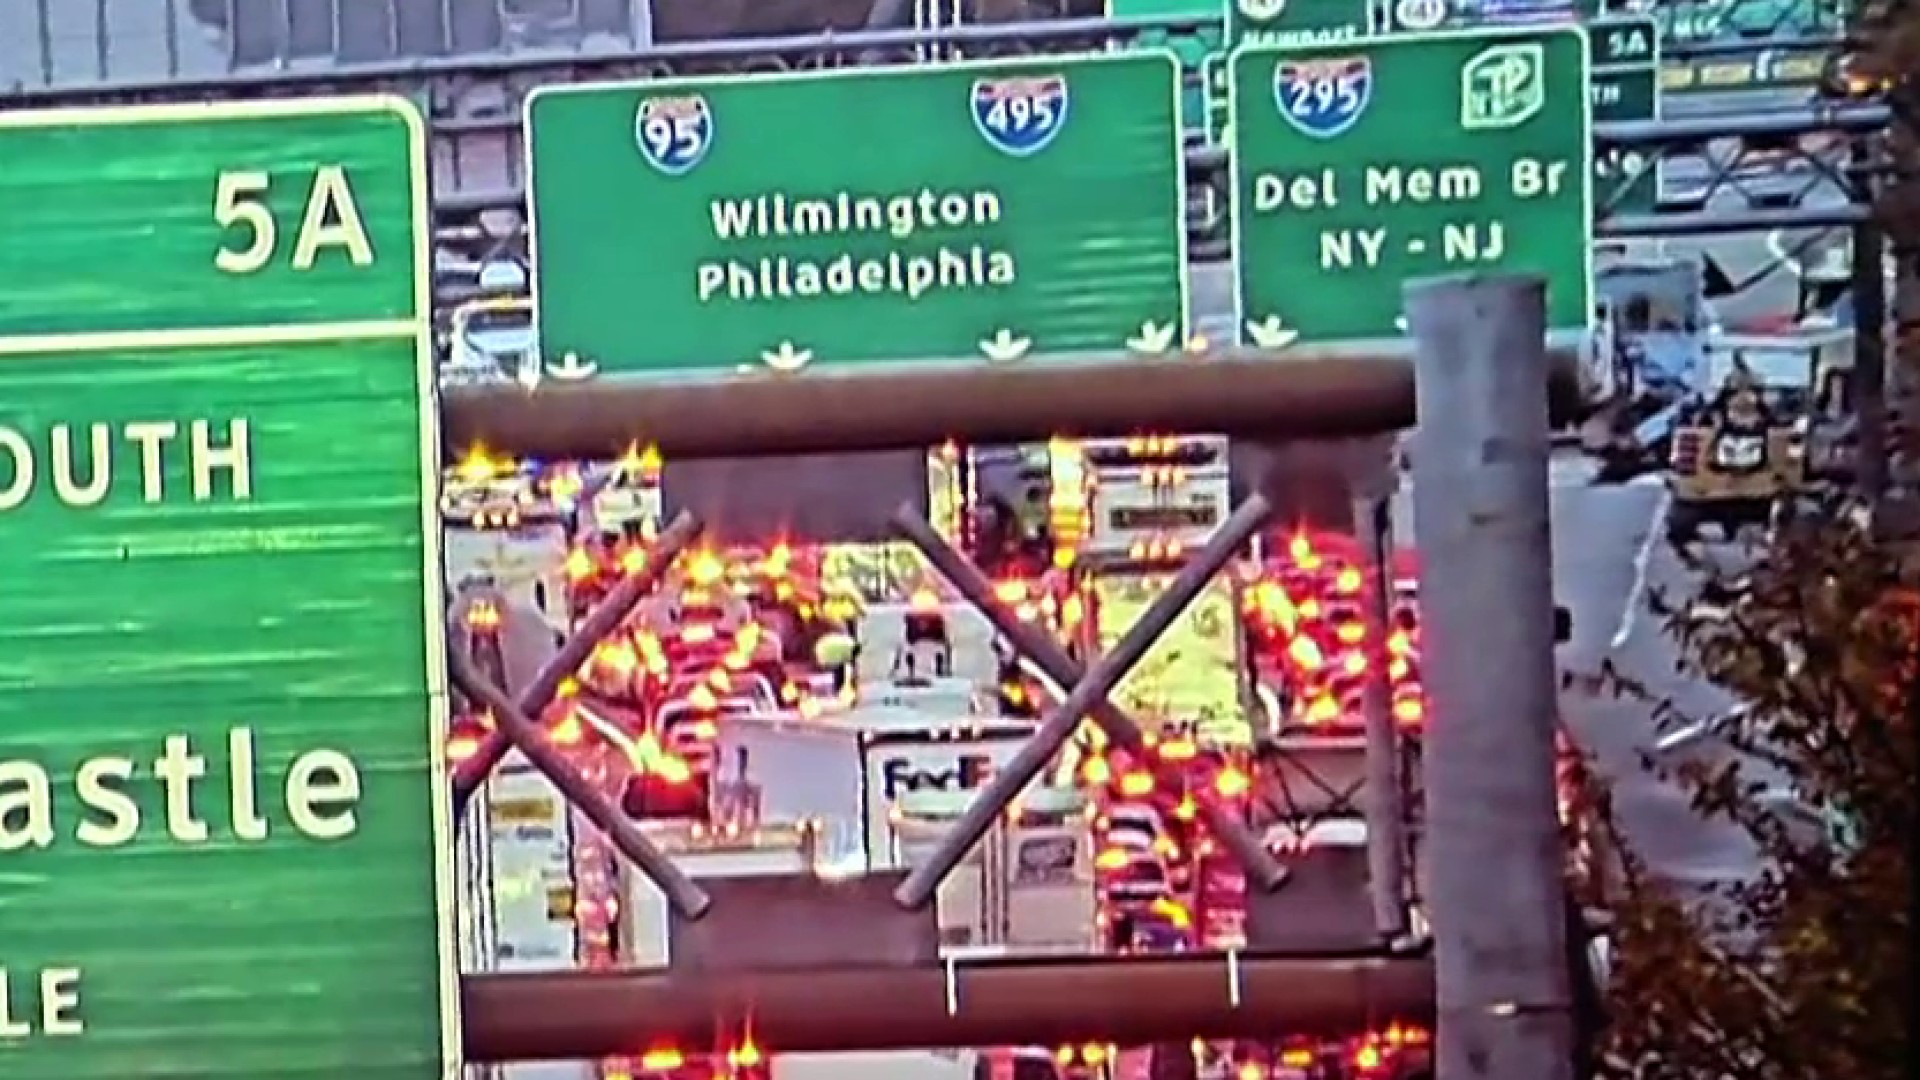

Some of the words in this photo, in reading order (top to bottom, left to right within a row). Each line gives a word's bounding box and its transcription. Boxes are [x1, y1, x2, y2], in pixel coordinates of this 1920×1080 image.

[986, 97, 1053, 134] 495
[1291, 80, 1358, 115] 295
[645, 118, 701, 158] 95
[1255, 168, 1338, 212] Del
[1366, 166, 1481, 205] Mem
[1512, 158, 1568, 198] Br
[215, 165, 375, 272] 5A
[710, 187, 1001, 239] Wilmington
[1320, 226, 1387, 270] NY
[1443, 220, 1504, 262] NJ
[698, 243, 1015, 302] Philadelphia
